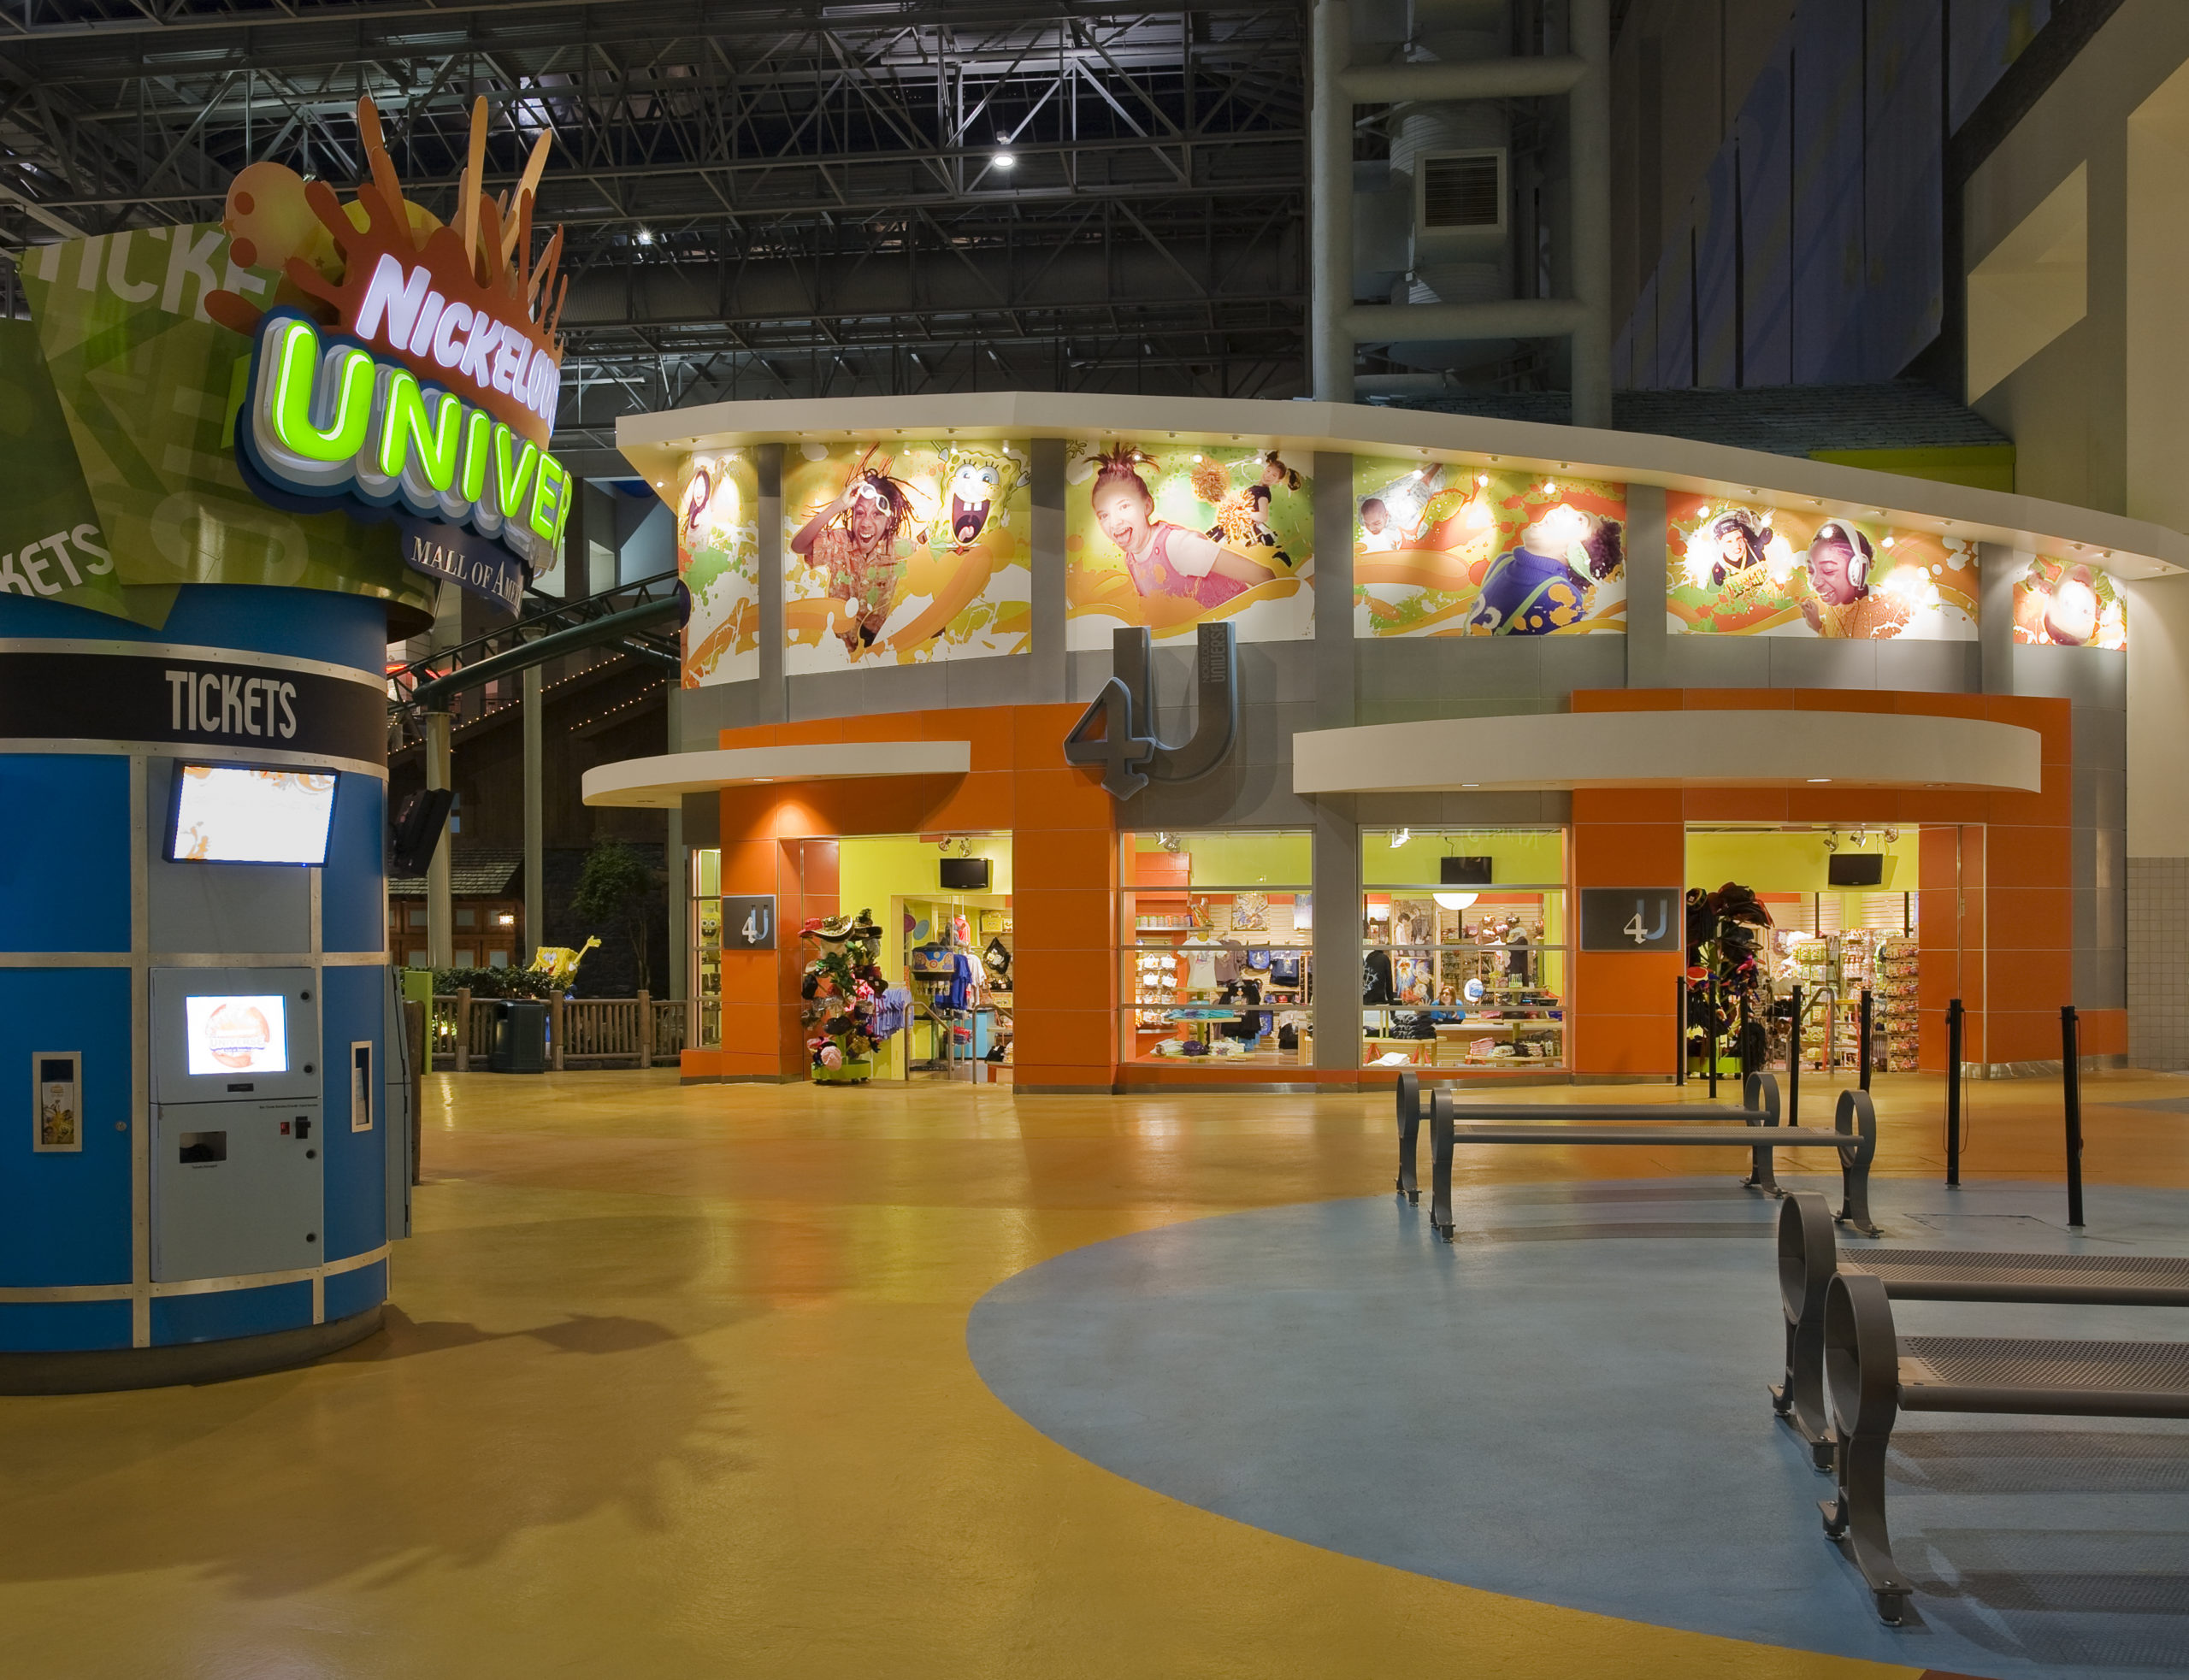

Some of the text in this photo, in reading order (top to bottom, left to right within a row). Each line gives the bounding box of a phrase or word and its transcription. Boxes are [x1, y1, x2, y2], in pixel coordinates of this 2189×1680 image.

[410, 535, 467, 580] MALL
[471, 561, 493, 589] OF
[1211, 623, 1225, 683] UNIVERSE
[165, 669, 297, 739] TICKETS
[1063, 622, 1237, 801] 4U
[741, 905, 769, 944] 4U
[1623, 899, 1668, 945] 4U
